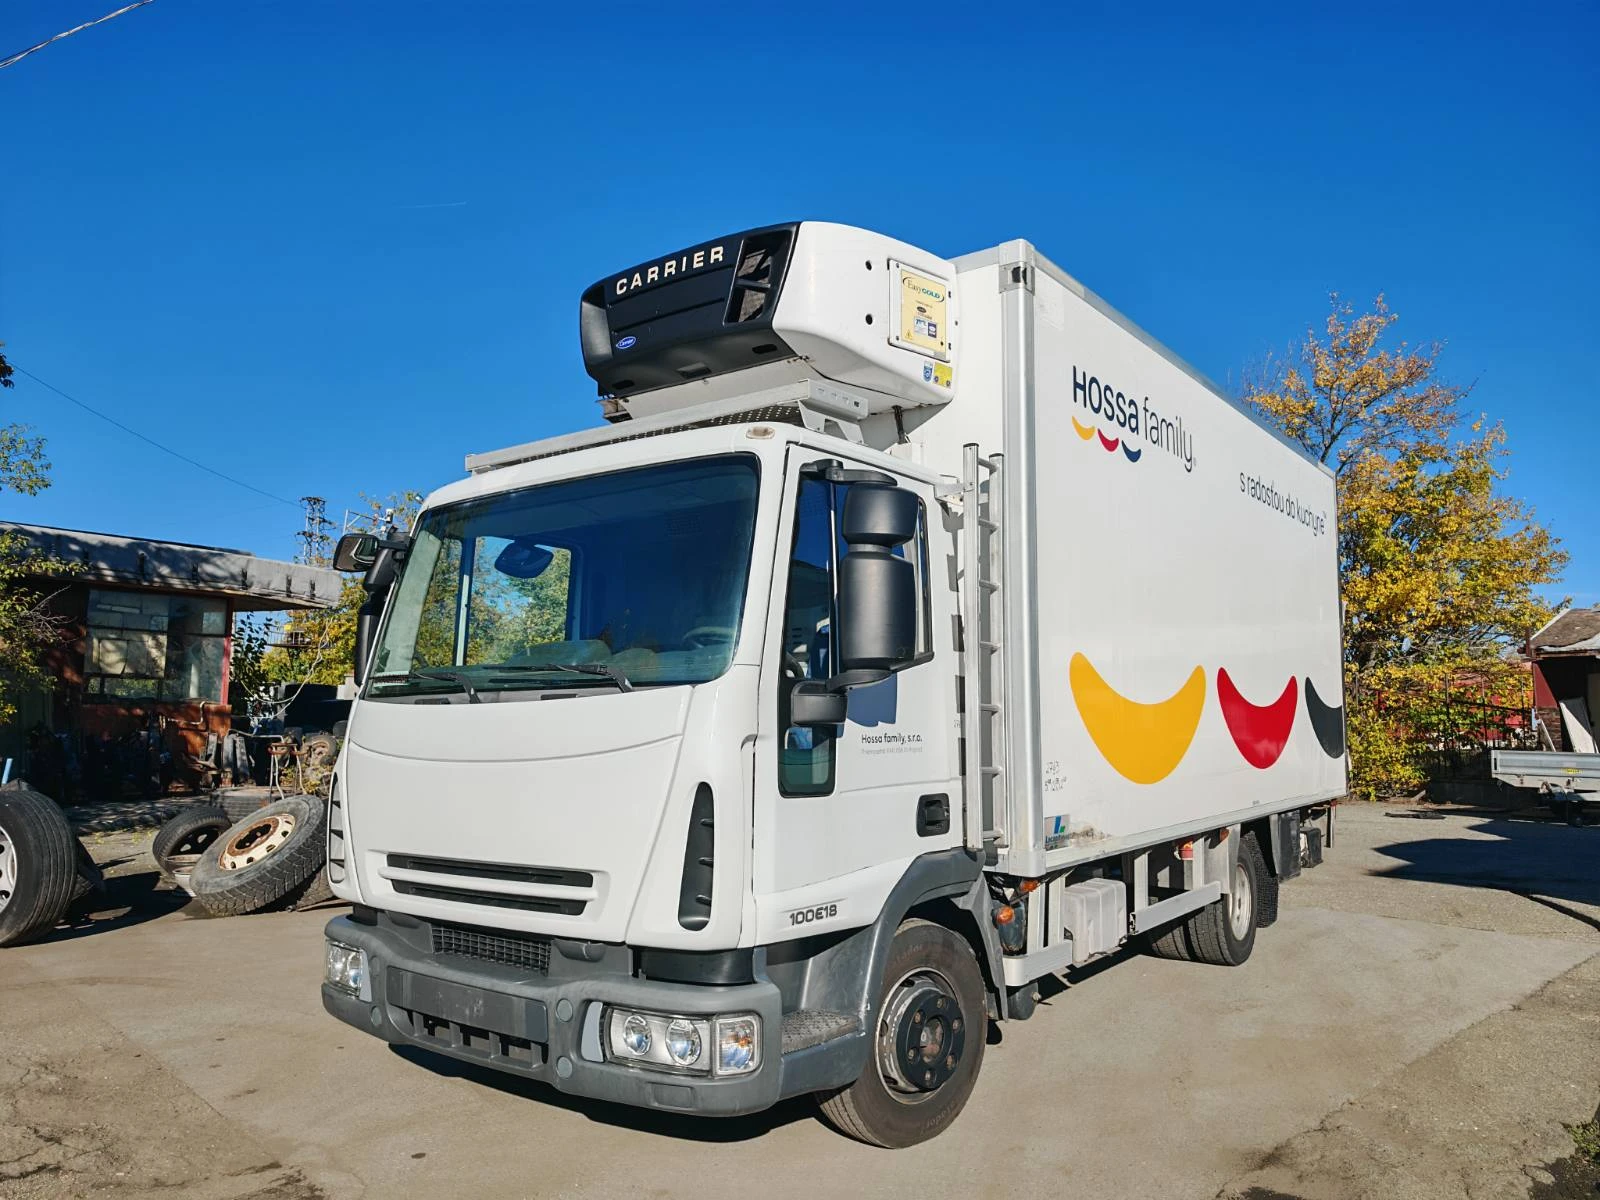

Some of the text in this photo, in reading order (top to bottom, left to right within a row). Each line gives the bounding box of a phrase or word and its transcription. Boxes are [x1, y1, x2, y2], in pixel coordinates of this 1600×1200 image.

[615, 246, 725, 295] CARRIER
[1143, 396, 1194, 473] family
[1239, 472, 1246, 493] s
[1285, 493, 1296, 519] do
[861, 733, 883, 744] Hossa
[907, 734, 923, 743] s.r.o.
[788, 904, 838, 926] 100E18
